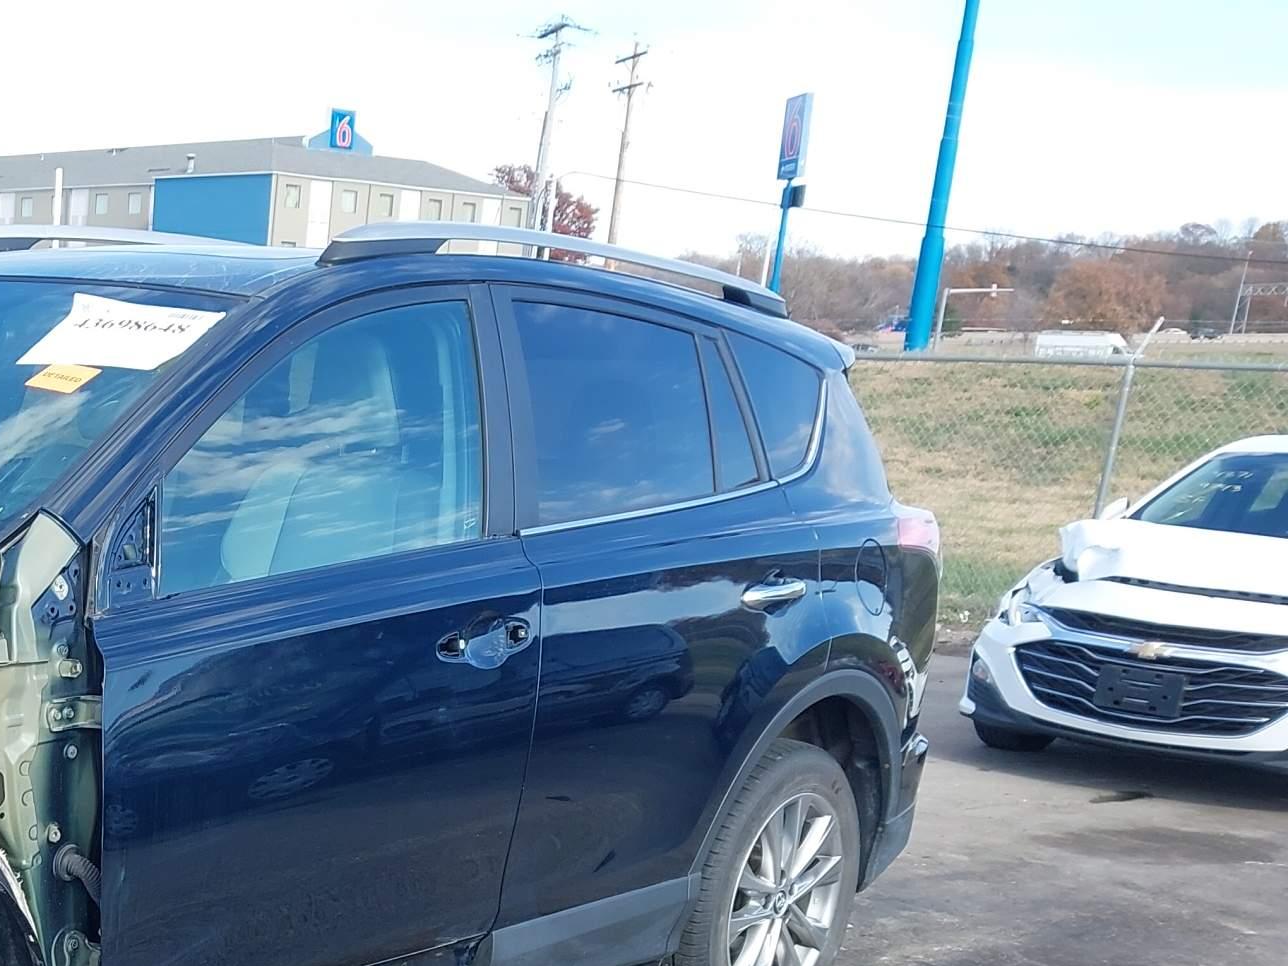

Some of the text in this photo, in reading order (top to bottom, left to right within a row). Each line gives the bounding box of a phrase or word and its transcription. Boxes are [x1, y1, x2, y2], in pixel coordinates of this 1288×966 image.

[336, 115, 352, 148] 6
[784, 101, 802, 160] 6
[73, 318, 191, 334] 43698648
